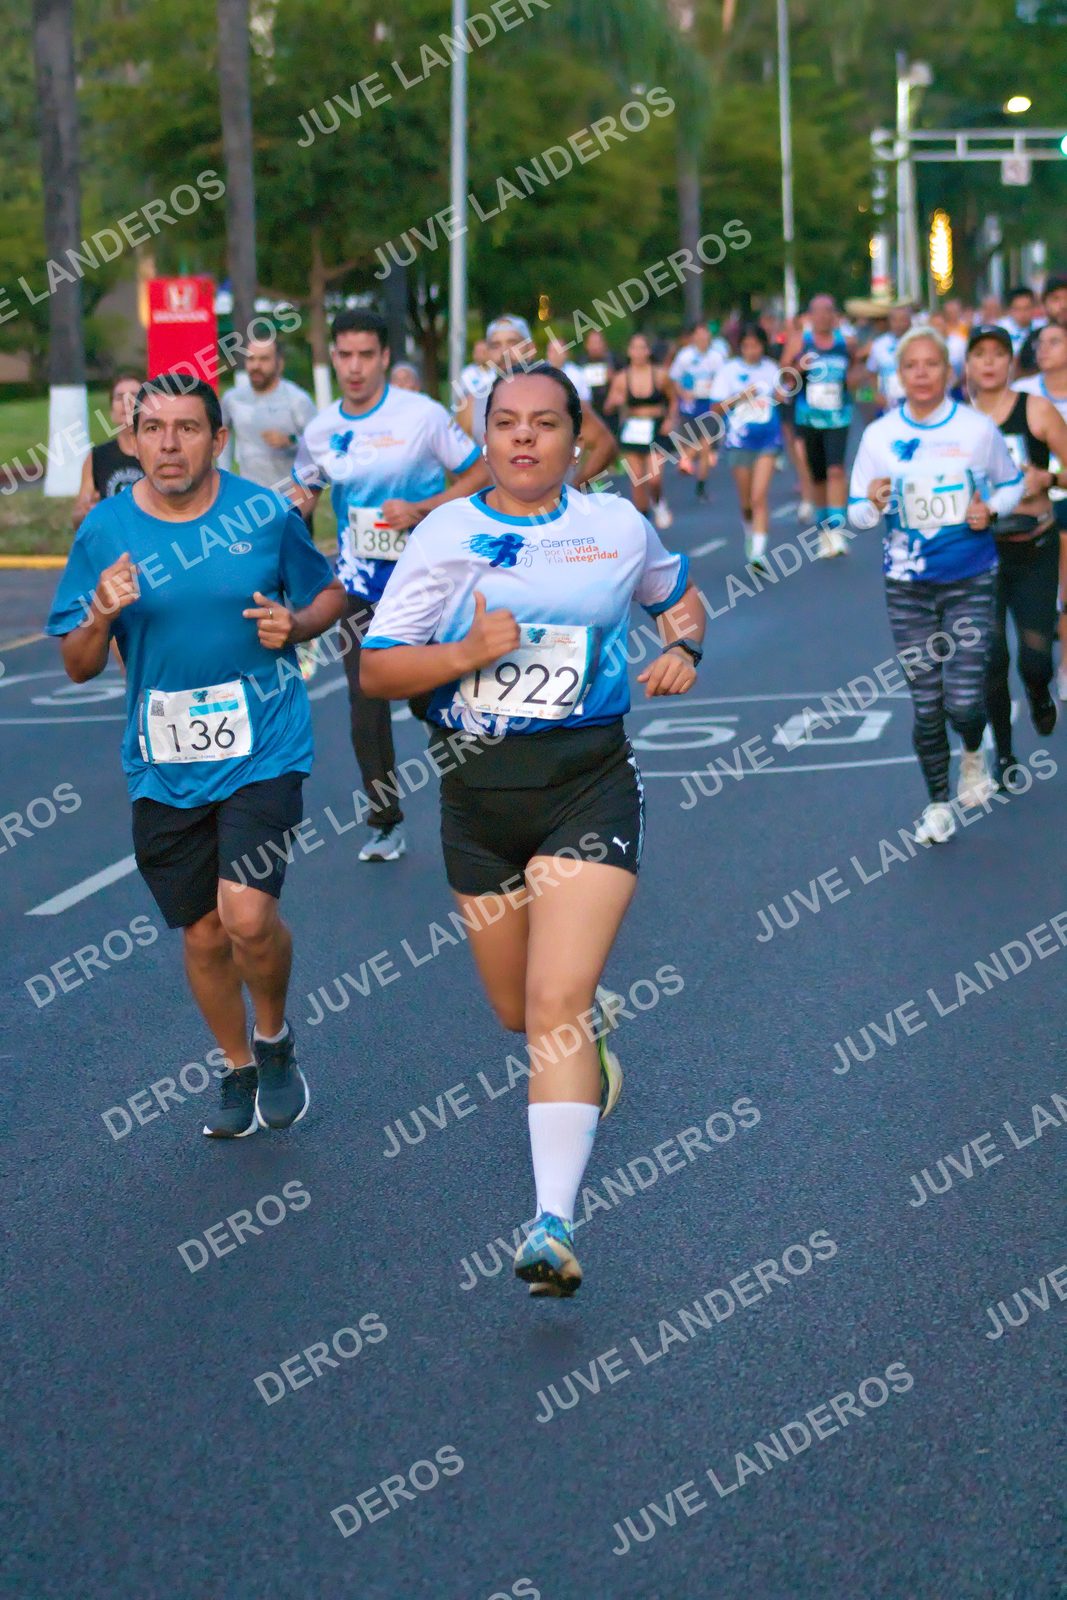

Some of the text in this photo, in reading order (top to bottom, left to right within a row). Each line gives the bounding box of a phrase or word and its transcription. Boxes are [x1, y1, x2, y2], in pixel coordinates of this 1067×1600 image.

[914, 494, 958, 521] 301
[352, 528, 407, 553] 1386
[541, 536, 596, 548] Carrera
[574, 544, 599, 554] Vida
[565, 550, 618, 563] Integridad
[473, 662, 579, 706] 1922
[167, 717, 235, 753] 136
